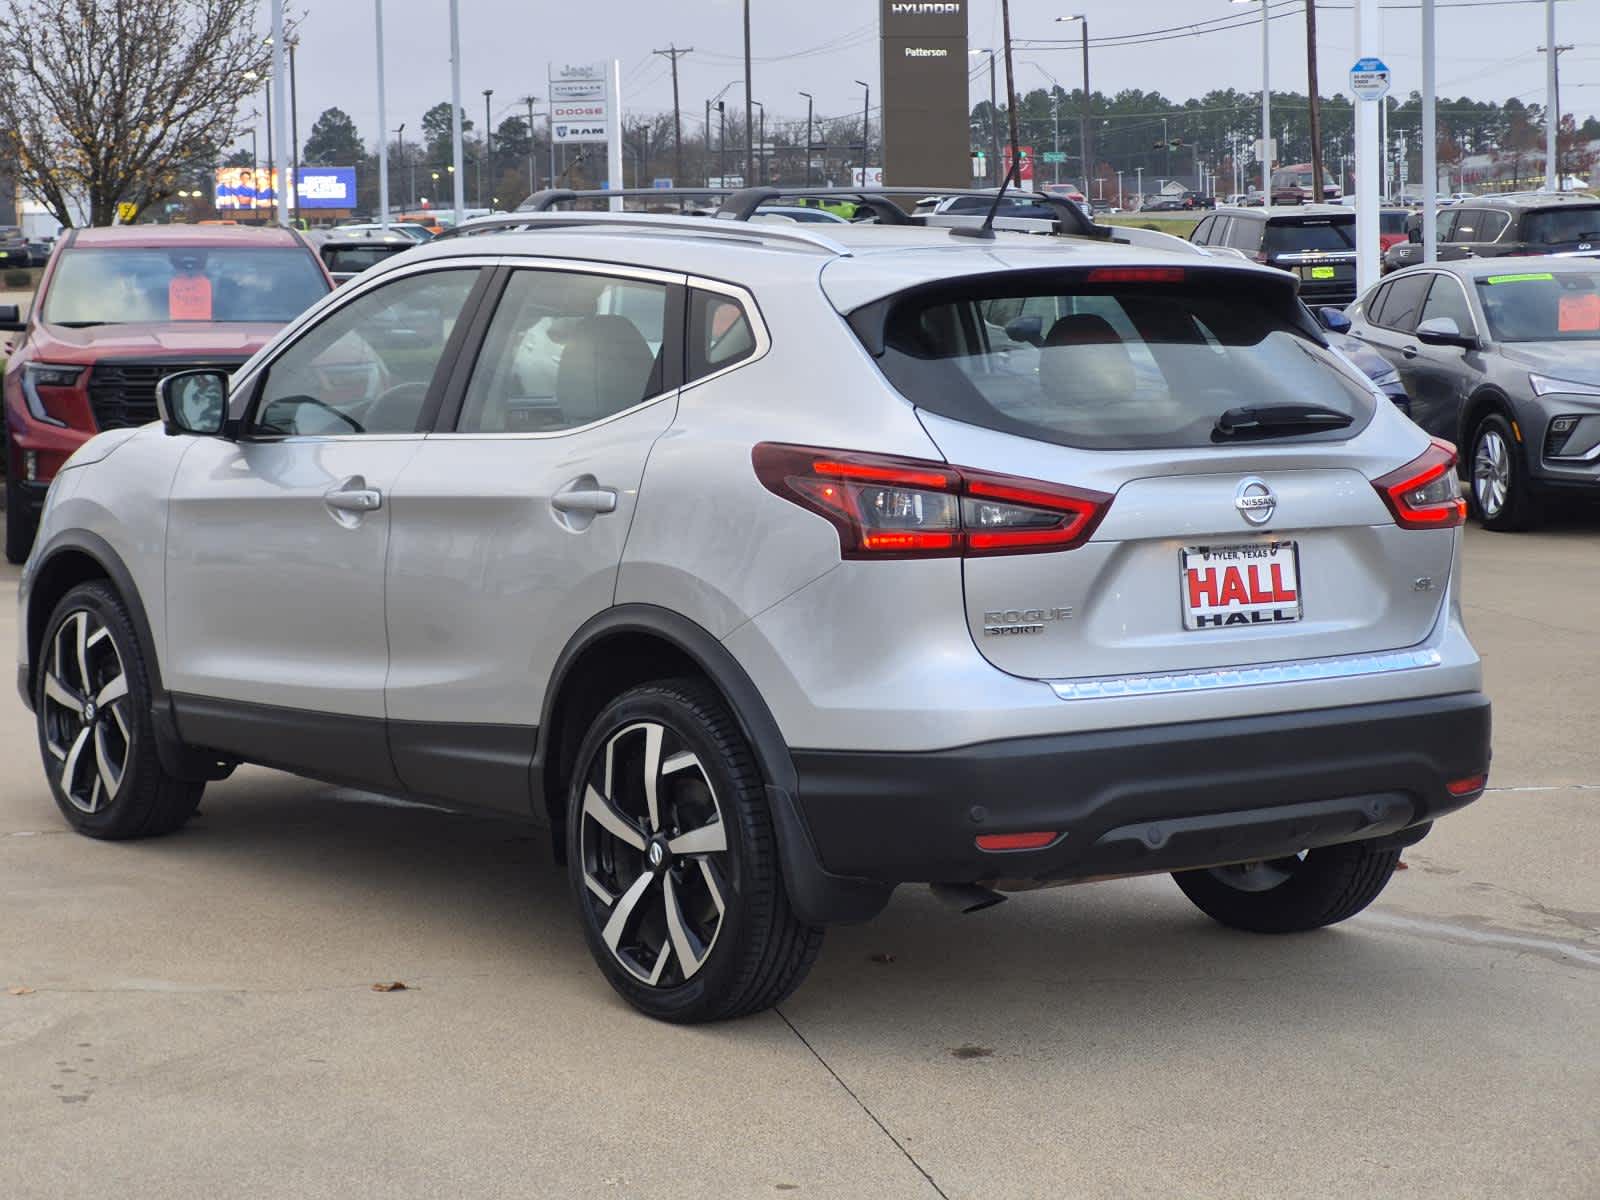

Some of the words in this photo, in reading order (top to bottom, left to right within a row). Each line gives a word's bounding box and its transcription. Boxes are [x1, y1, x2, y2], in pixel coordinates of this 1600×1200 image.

[892, 3, 960, 15] HYUNDAI
[905, 47, 947, 57] Patterson
[555, 107, 603, 116] DODGE
[1241, 497, 1274, 506] NISSAN
[1213, 552, 1240, 560] TYLER,
[1243, 550, 1268, 559] TEXAS
[1187, 563, 1297, 609] HALL
[984, 606, 1073, 625] ROGUE
[1196, 609, 1296, 627] HALL
[991, 625, 1038, 635] SPORT
